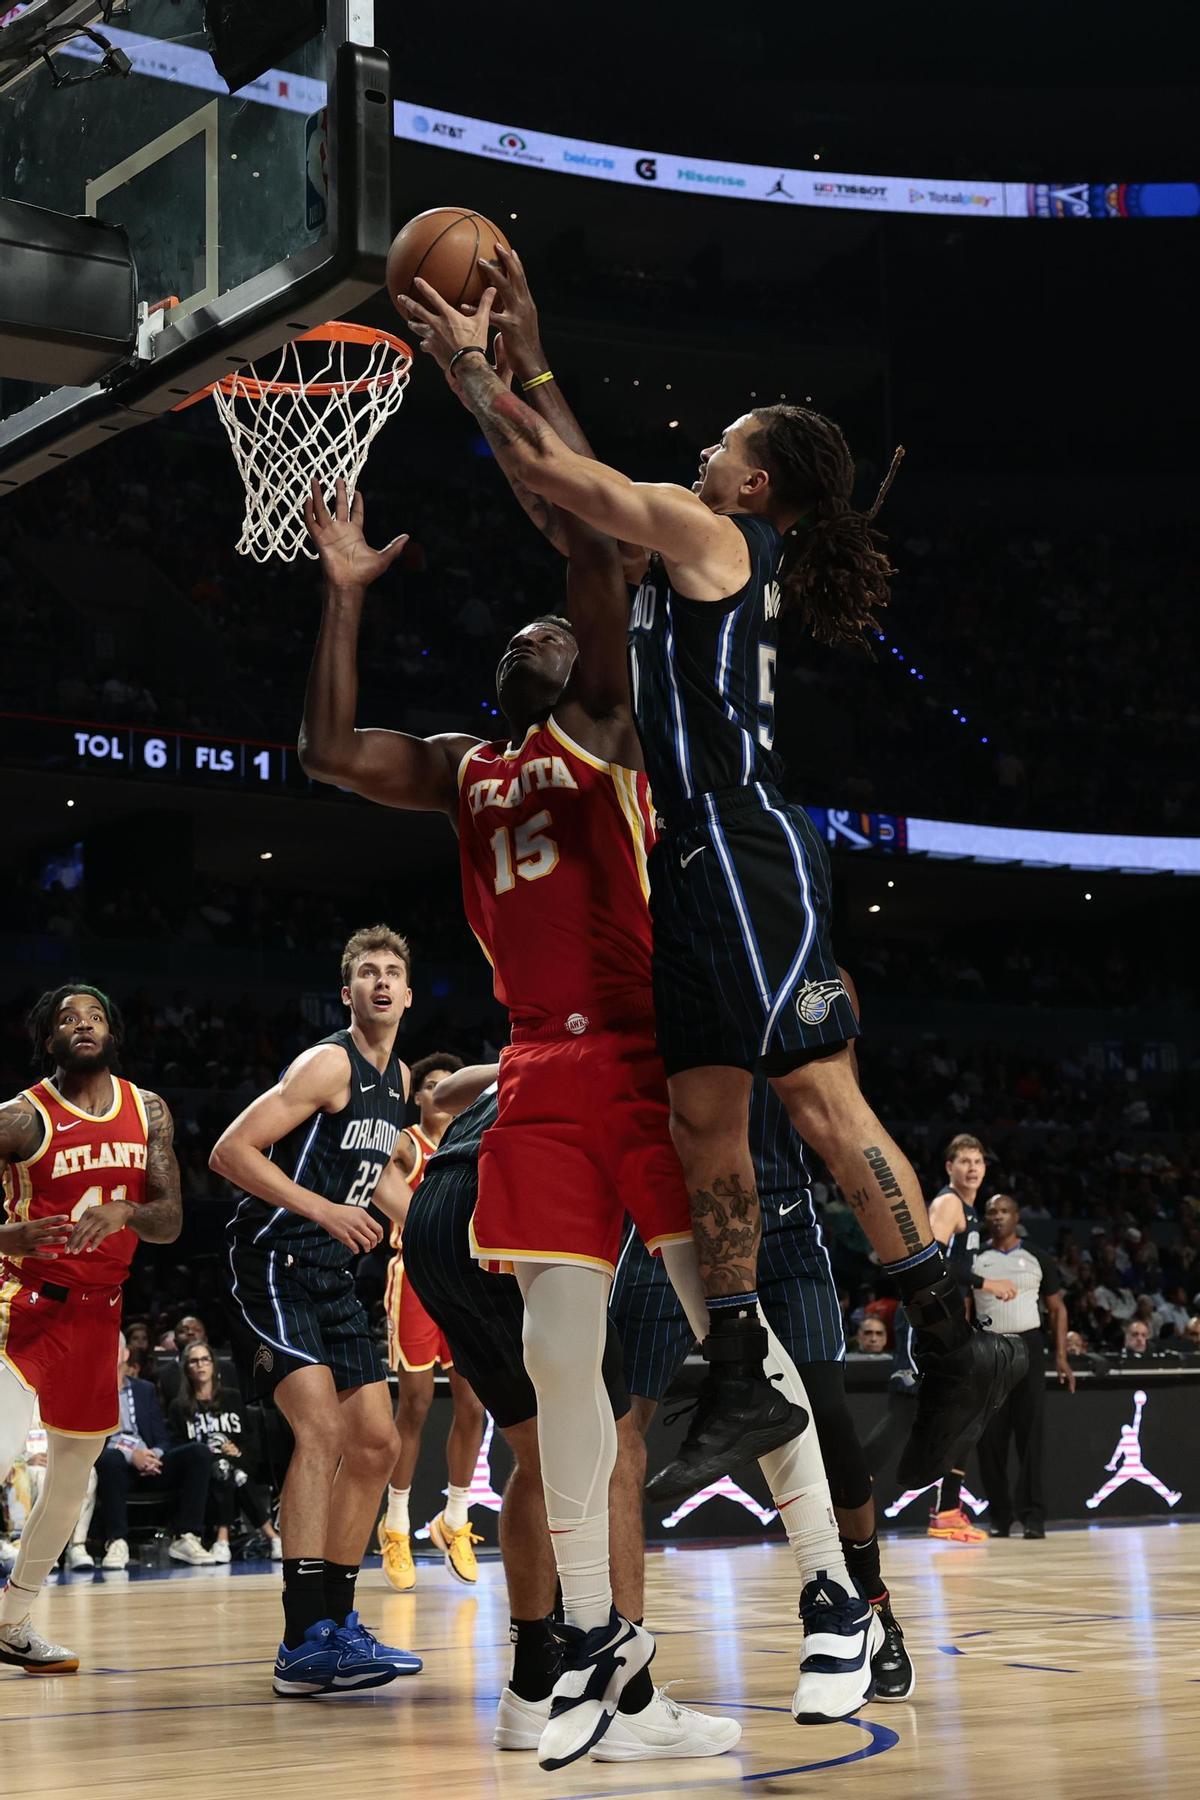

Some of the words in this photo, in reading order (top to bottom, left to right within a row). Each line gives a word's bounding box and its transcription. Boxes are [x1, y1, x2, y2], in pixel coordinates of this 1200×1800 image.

[432, 122, 465, 140] AT&T
[677, 168, 747, 188] Hisense
[74, 732, 124, 760] TOL
[143, 738, 167, 769] 6
[195, 746, 234, 772] FLS
[253, 751, 270, 780] 1
[489, 809, 560, 896] 15
[51, 1141, 148, 1180] ATLANT
[344, 1160, 384, 1209] 22
[863, 1146, 903, 1199] COUNT
